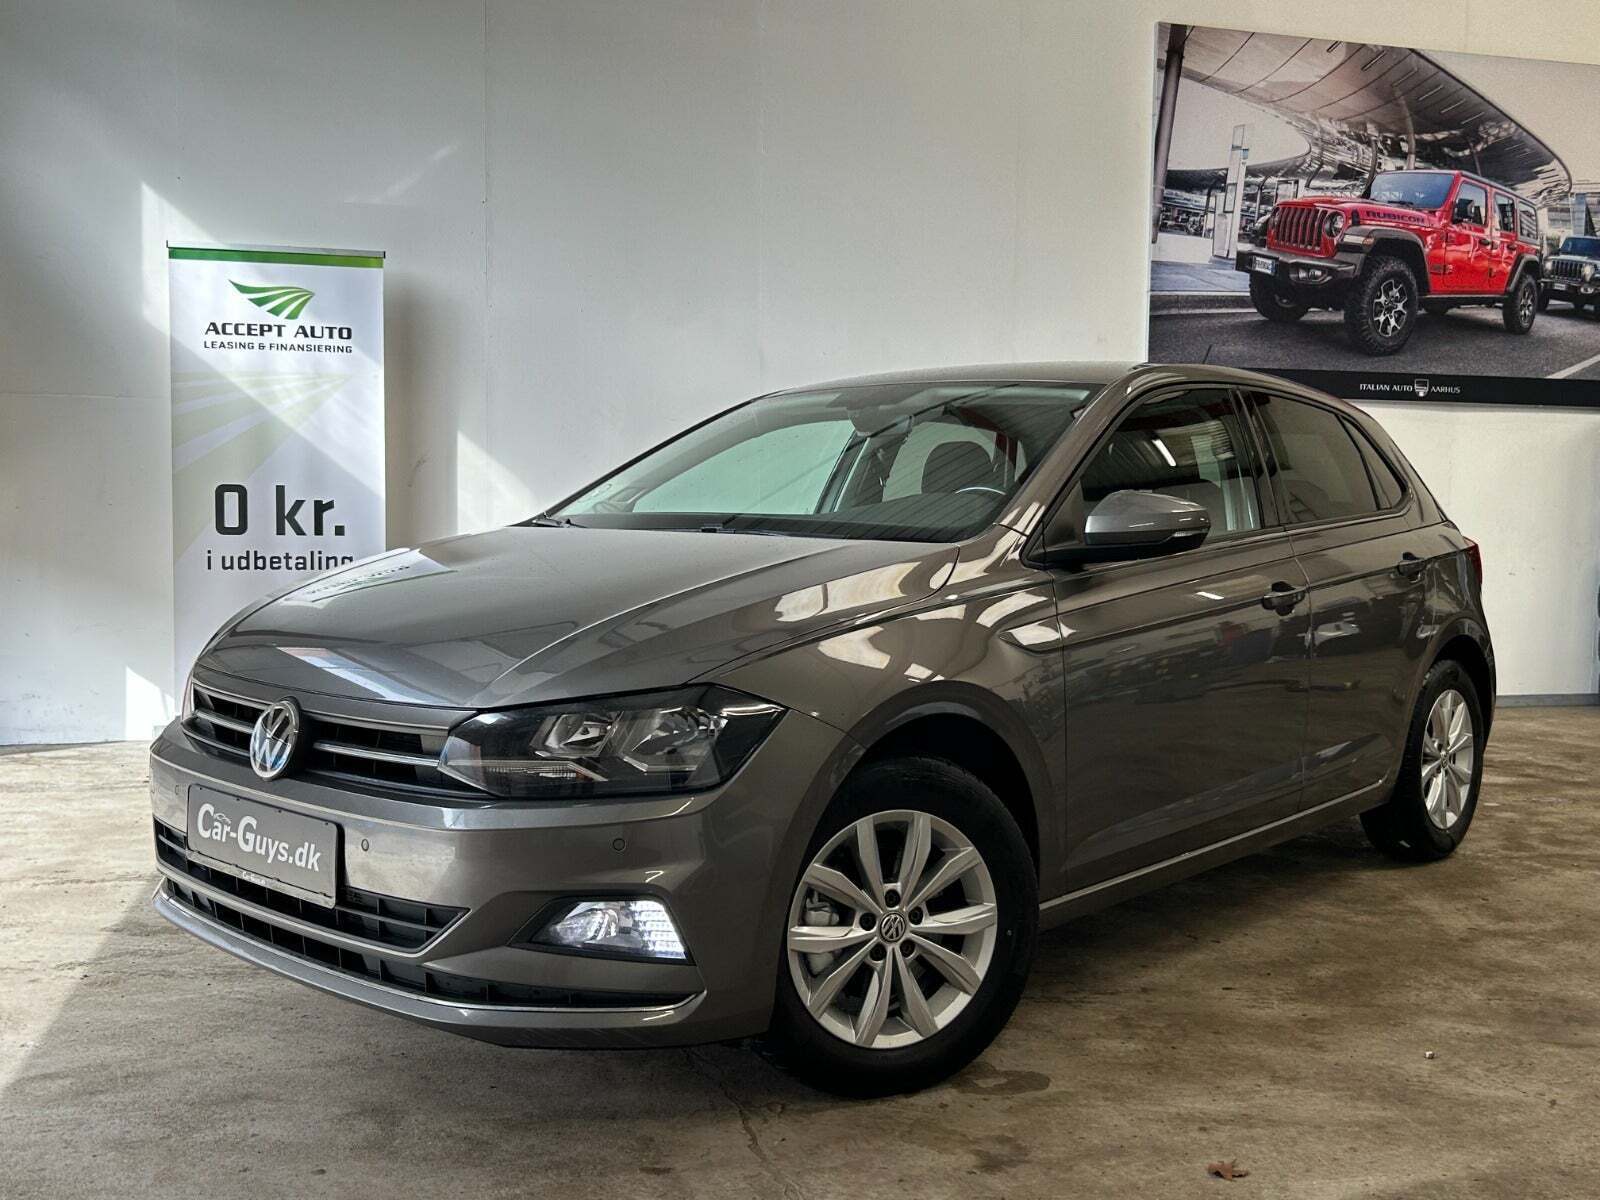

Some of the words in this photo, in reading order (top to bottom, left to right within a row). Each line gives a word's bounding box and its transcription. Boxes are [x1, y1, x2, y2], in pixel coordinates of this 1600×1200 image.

[1366, 210, 1425, 223] RUBICON
[204, 321, 286, 338] ACCEPT
[294, 325, 353, 340] AUTO
[203, 340, 255, 350] LEASING
[258, 342, 266, 351] &
[269, 343, 353, 353] FINANSIERING
[1359, 383, 1390, 392] ITALIAN
[1392, 384, 1413, 392] AUTO
[1430, 386, 1461, 394] AARHUS
[275, 484, 345, 536] kr.
[207, 549, 212, 570] i
[196, 802, 322, 872] Car-Guys.dk
